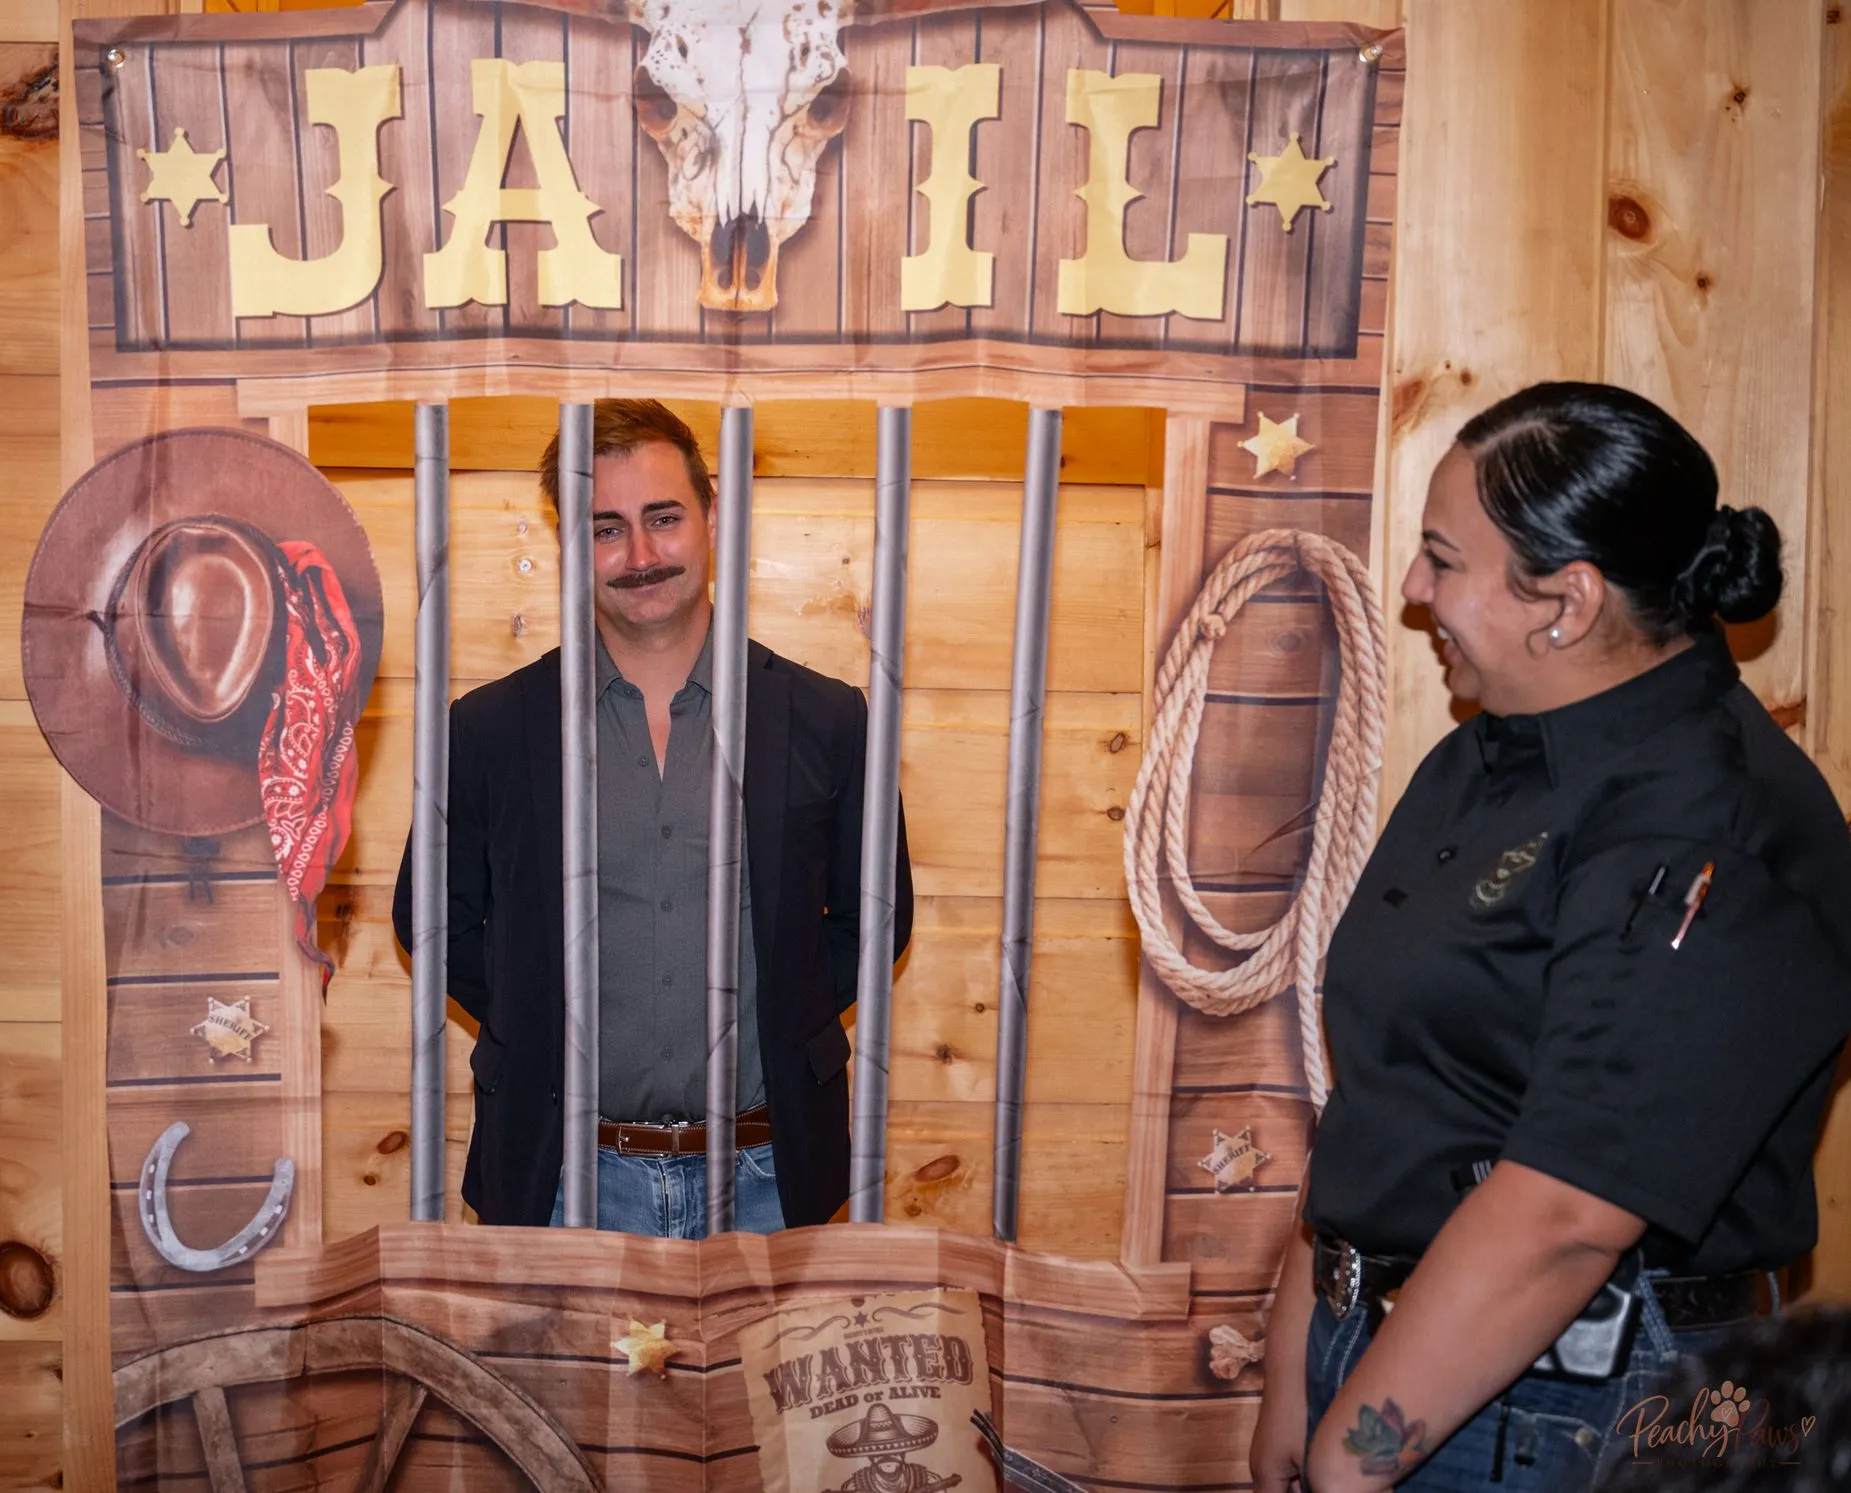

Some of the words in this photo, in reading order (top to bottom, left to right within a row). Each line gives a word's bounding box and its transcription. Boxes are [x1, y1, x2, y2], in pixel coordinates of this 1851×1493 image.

[229, 59, 1228, 318] JAIL
[208, 1015, 253, 1041] SHERIFF
[1213, 1143, 1250, 1175] SHERIFF
[763, 1333, 973, 1414] WANTED
[809, 1394, 860, 1420] DEAD
[888, 1386, 941, 1399] ALIVE
